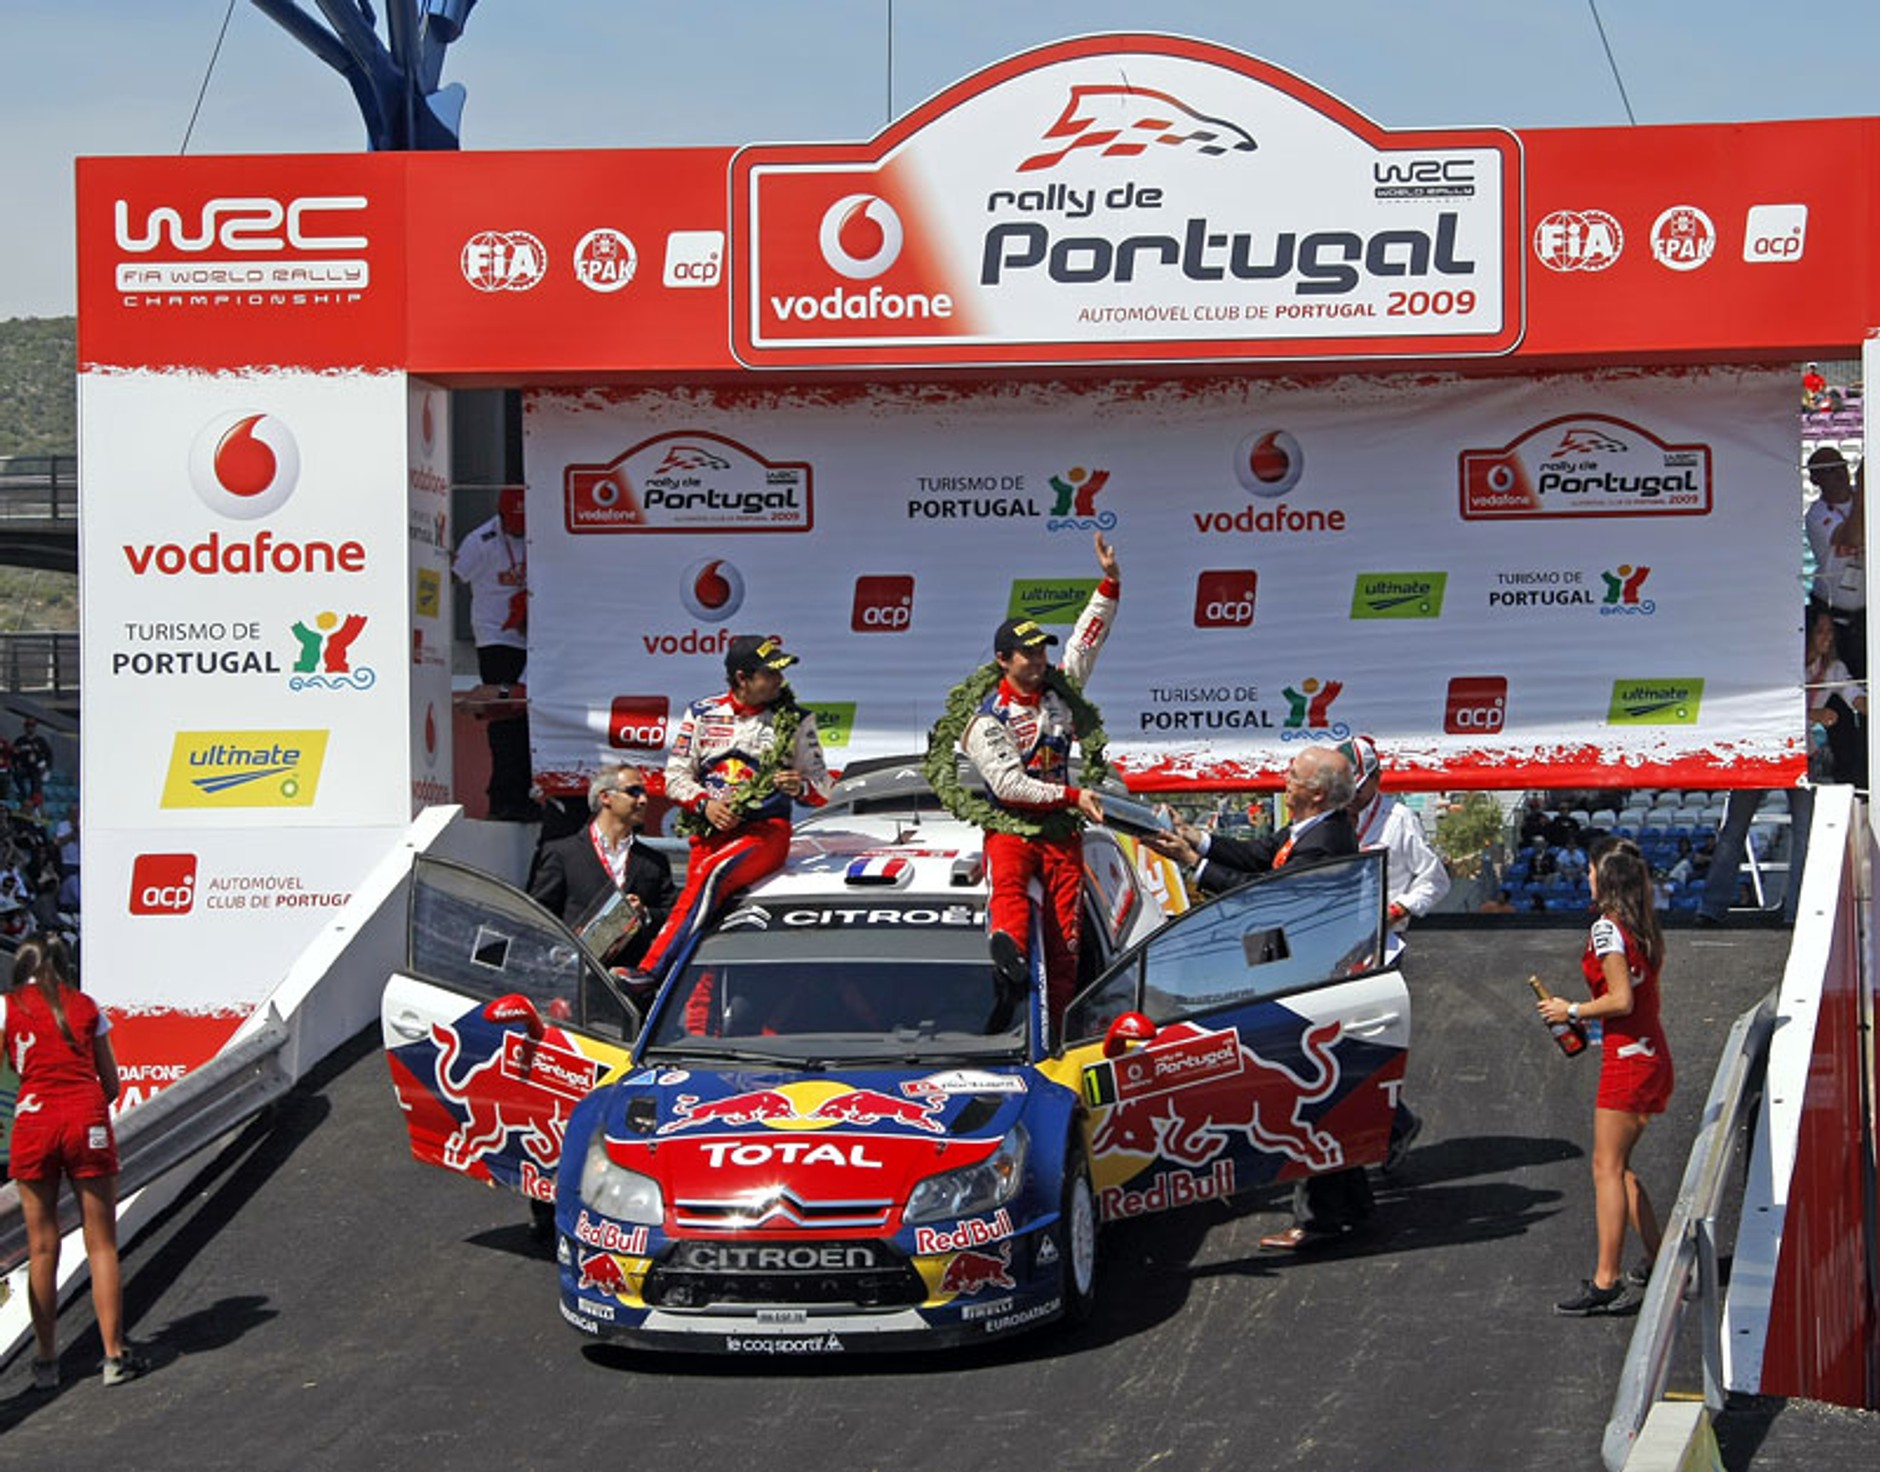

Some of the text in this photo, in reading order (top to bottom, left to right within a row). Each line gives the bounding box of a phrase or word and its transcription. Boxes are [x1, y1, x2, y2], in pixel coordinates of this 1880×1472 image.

[1374, 160, 1474, 183] WRC
[988, 183, 1163, 217] rally de
[115, 196, 368, 252] WRC
[981, 212, 1475, 294] Portugal
[1754, 237, 1799, 257] acp
[124, 267, 361, 284] FIA WORLD RALLY
[673, 259, 718, 282] acp
[123, 294, 362, 306] CHAMPIONSHIP
[771, 287, 952, 320] vodafone
[1079, 290, 1476, 322] AUTOMÓVEL CLUB DE PORTUGAL 2009
[683, 476, 702, 486] de
[917, 476, 1025, 491] TURISMO DE
[1539, 471, 1698, 496] Portugal
[644, 489, 799, 513] Portugal
[908, 499, 1041, 519] PORTUGAL
[577, 509, 637, 521] vodafone
[1193, 504, 1346, 533] vodafone
[122, 531, 366, 575] vodafone
[1366, 583, 1430, 596] ultimate
[1498, 572, 1583, 585] TURISMO DE
[1021, 587, 1087, 602] ultimate
[1489, 590, 1594, 606] PORTUGAL
[864, 605, 909, 627] acp
[1207, 601, 1253, 622] acp
[125, 622, 261, 641] TURISMO DE
[643, 628, 783, 655] vodafe
[113, 652, 280, 674] PORTUGAL
[1150, 686, 1258, 703] TURISMO DE
[1622, 686, 1688, 702] ultimate
[1141, 709, 1274, 731] PORTUGAL
[1456, 706, 1502, 729] acp
[620, 722, 664, 746] acp
[190, 744, 300, 767] ultimate
[209, 876, 304, 891] AUTOMÓVEL
[142, 884, 192, 910] acp
[207, 896, 246, 909] CLUB
[251, 895, 270, 908] DE
[1156, 1048, 1235, 1076] Portugal
[1087, 1068, 1101, 1104] 1
[700, 1141, 883, 1168] TOTAL
[520, 1161, 556, 1200] Re
[1100, 1157, 1235, 1221] Red Bull
[574, 1210, 649, 1255] Red Bull
[915, 1208, 1014, 1255] Red Bull
[727, 1335, 824, 1354] le coq sportif
